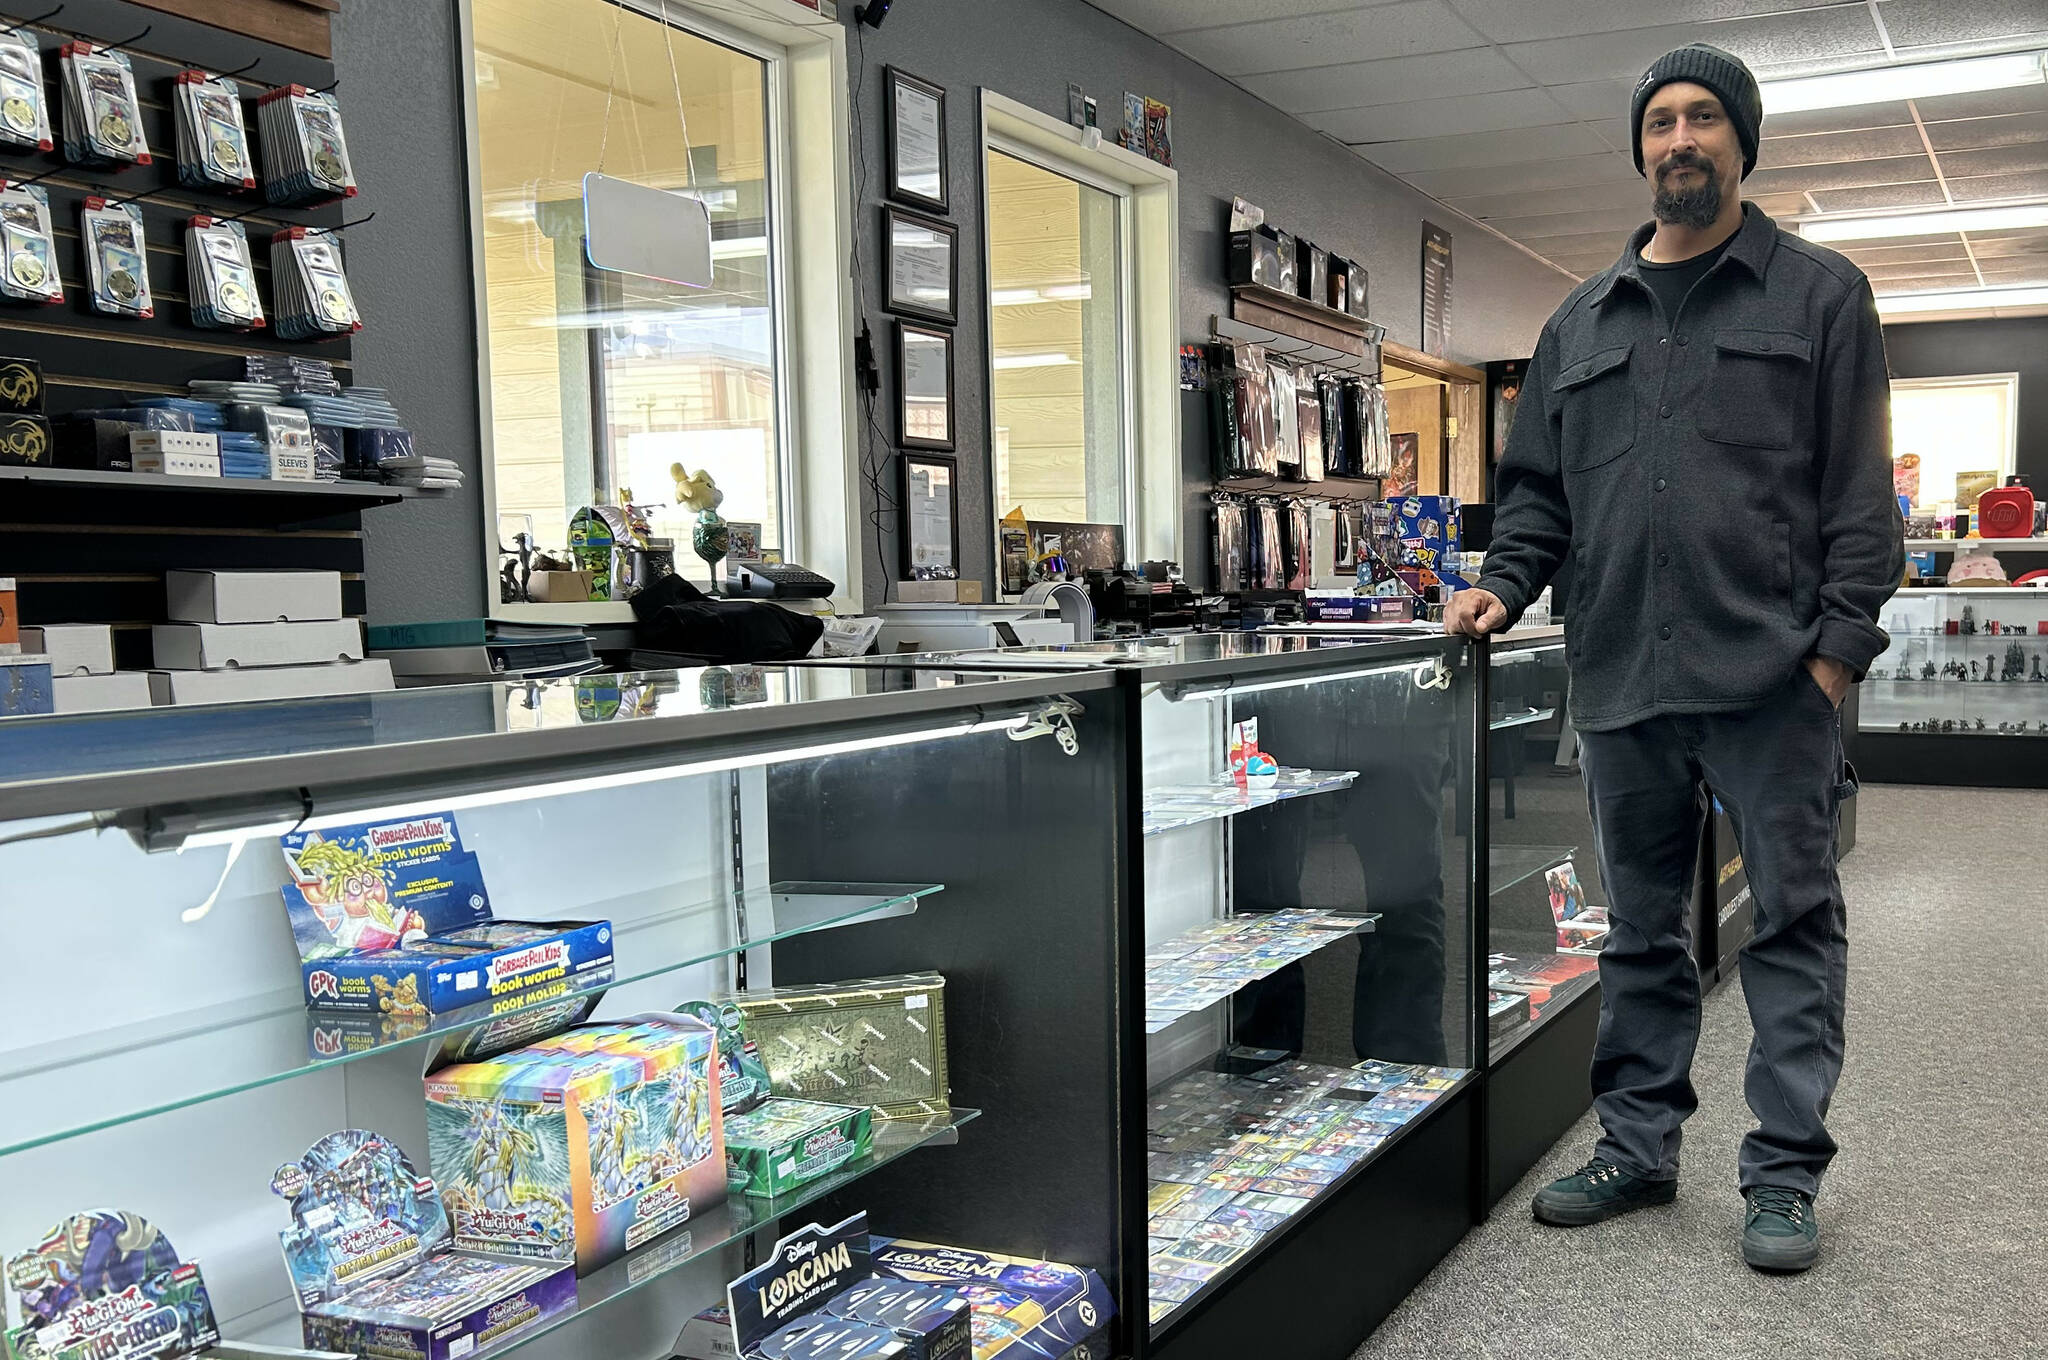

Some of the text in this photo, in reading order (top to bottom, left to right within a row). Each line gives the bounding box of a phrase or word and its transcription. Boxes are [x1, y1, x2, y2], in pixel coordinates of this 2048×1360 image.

[278, 458, 308, 468] SLEEVES
[1991, 508, 2018, 522] LEGO
[371, 819, 444, 846] GARBAGE PAIL KIDS
[374, 841, 452, 864] book worms
[397, 854, 441, 868] STICKER CARDS
[394, 880, 454, 898] PREMIUM CONTENT!
[407, 877, 439, 889] EXCLUSIVE
[495, 944, 562, 976] GARBAGE PAIL KIDS
[310, 971, 339, 999] GPK
[339, 985, 371, 993] worms
[342, 976, 366, 986] book
[492, 965, 566, 996] book worms
[428, 1083, 458, 1094] KONAMI
[333, 1235, 419, 1279] TACTICAL MASTERS
[783, 1240, 818, 1263] Disney
[878, 1250, 1005, 1279] LORCANA
[890, 1262, 973, 1279] TRADING CARD GAME
[758, 1241, 853, 1319] LORCANA
[776, 1277, 838, 1319] TRADING CARD GAME
[126, 1307, 179, 1347] LEGEND
[929, 1323, 969, 1360] LORCANA
